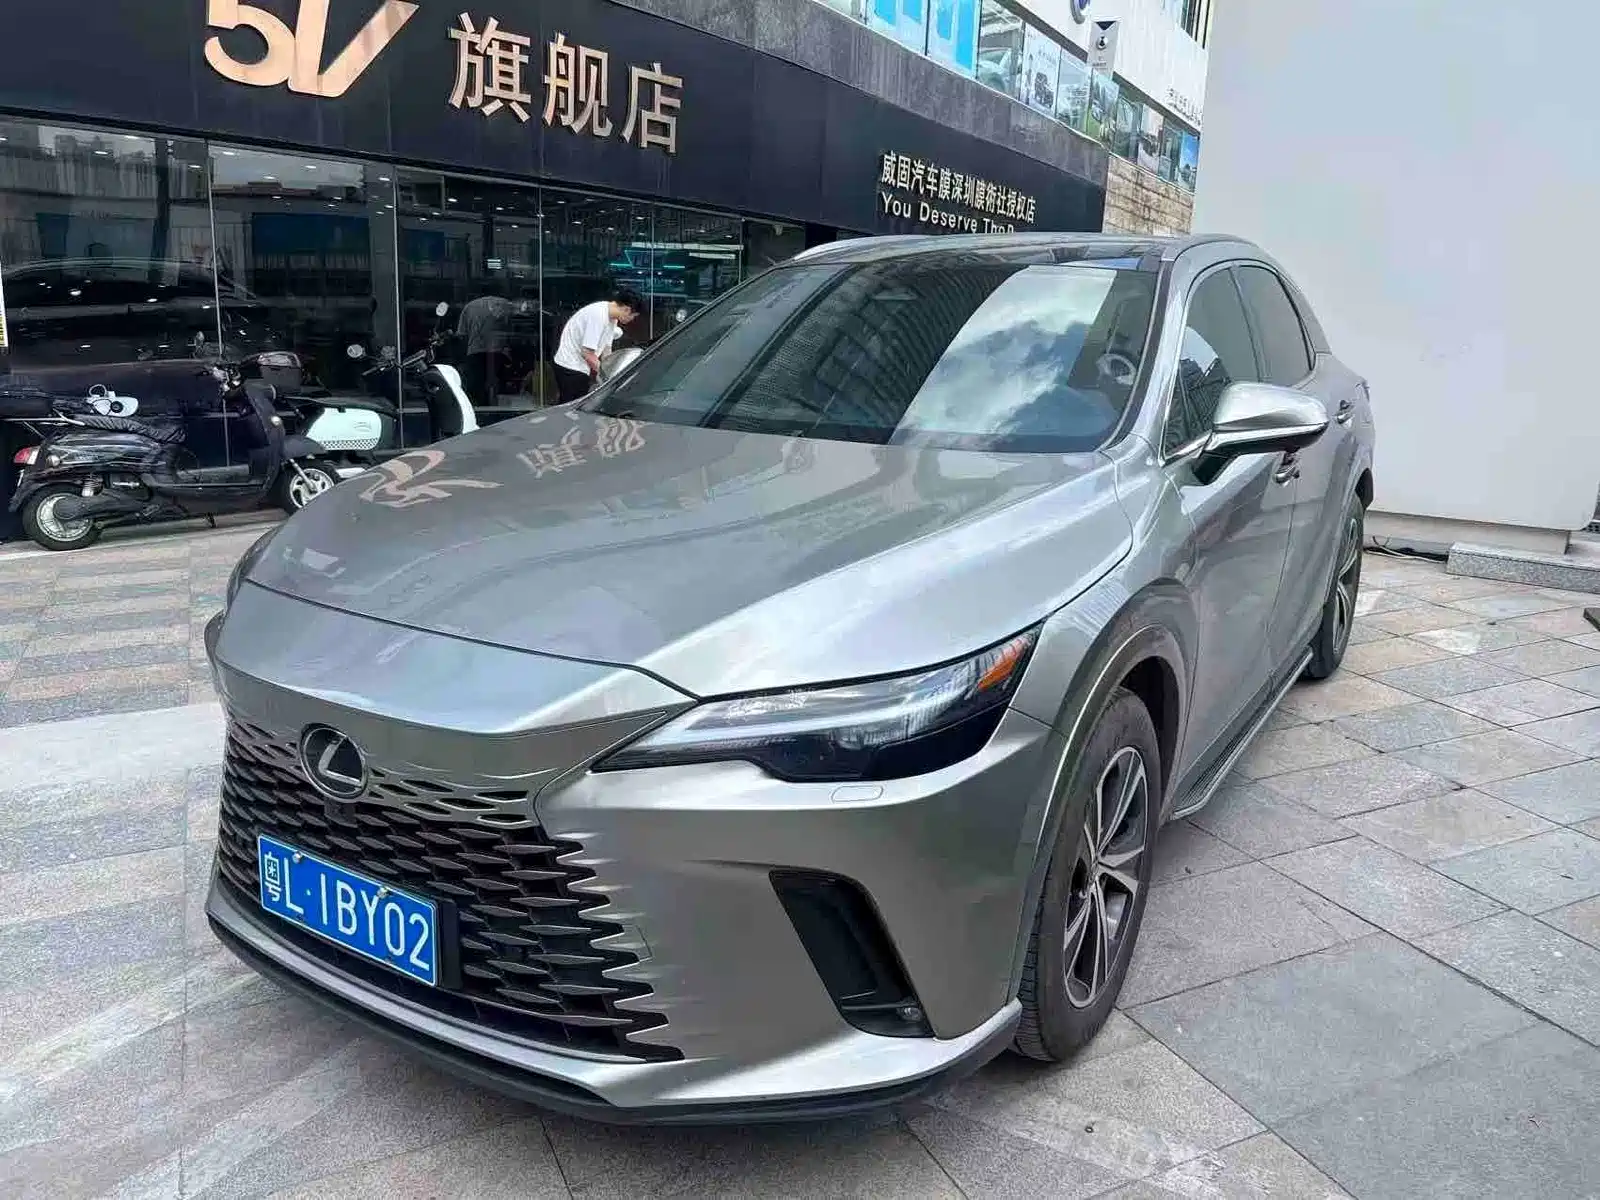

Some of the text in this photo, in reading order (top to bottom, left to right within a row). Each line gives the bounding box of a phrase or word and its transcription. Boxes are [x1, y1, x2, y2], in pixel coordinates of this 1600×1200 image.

[448, 12, 684, 153] 旗舰店
[881, 191, 912, 219] You
[919, 203, 978, 233] Deserve
